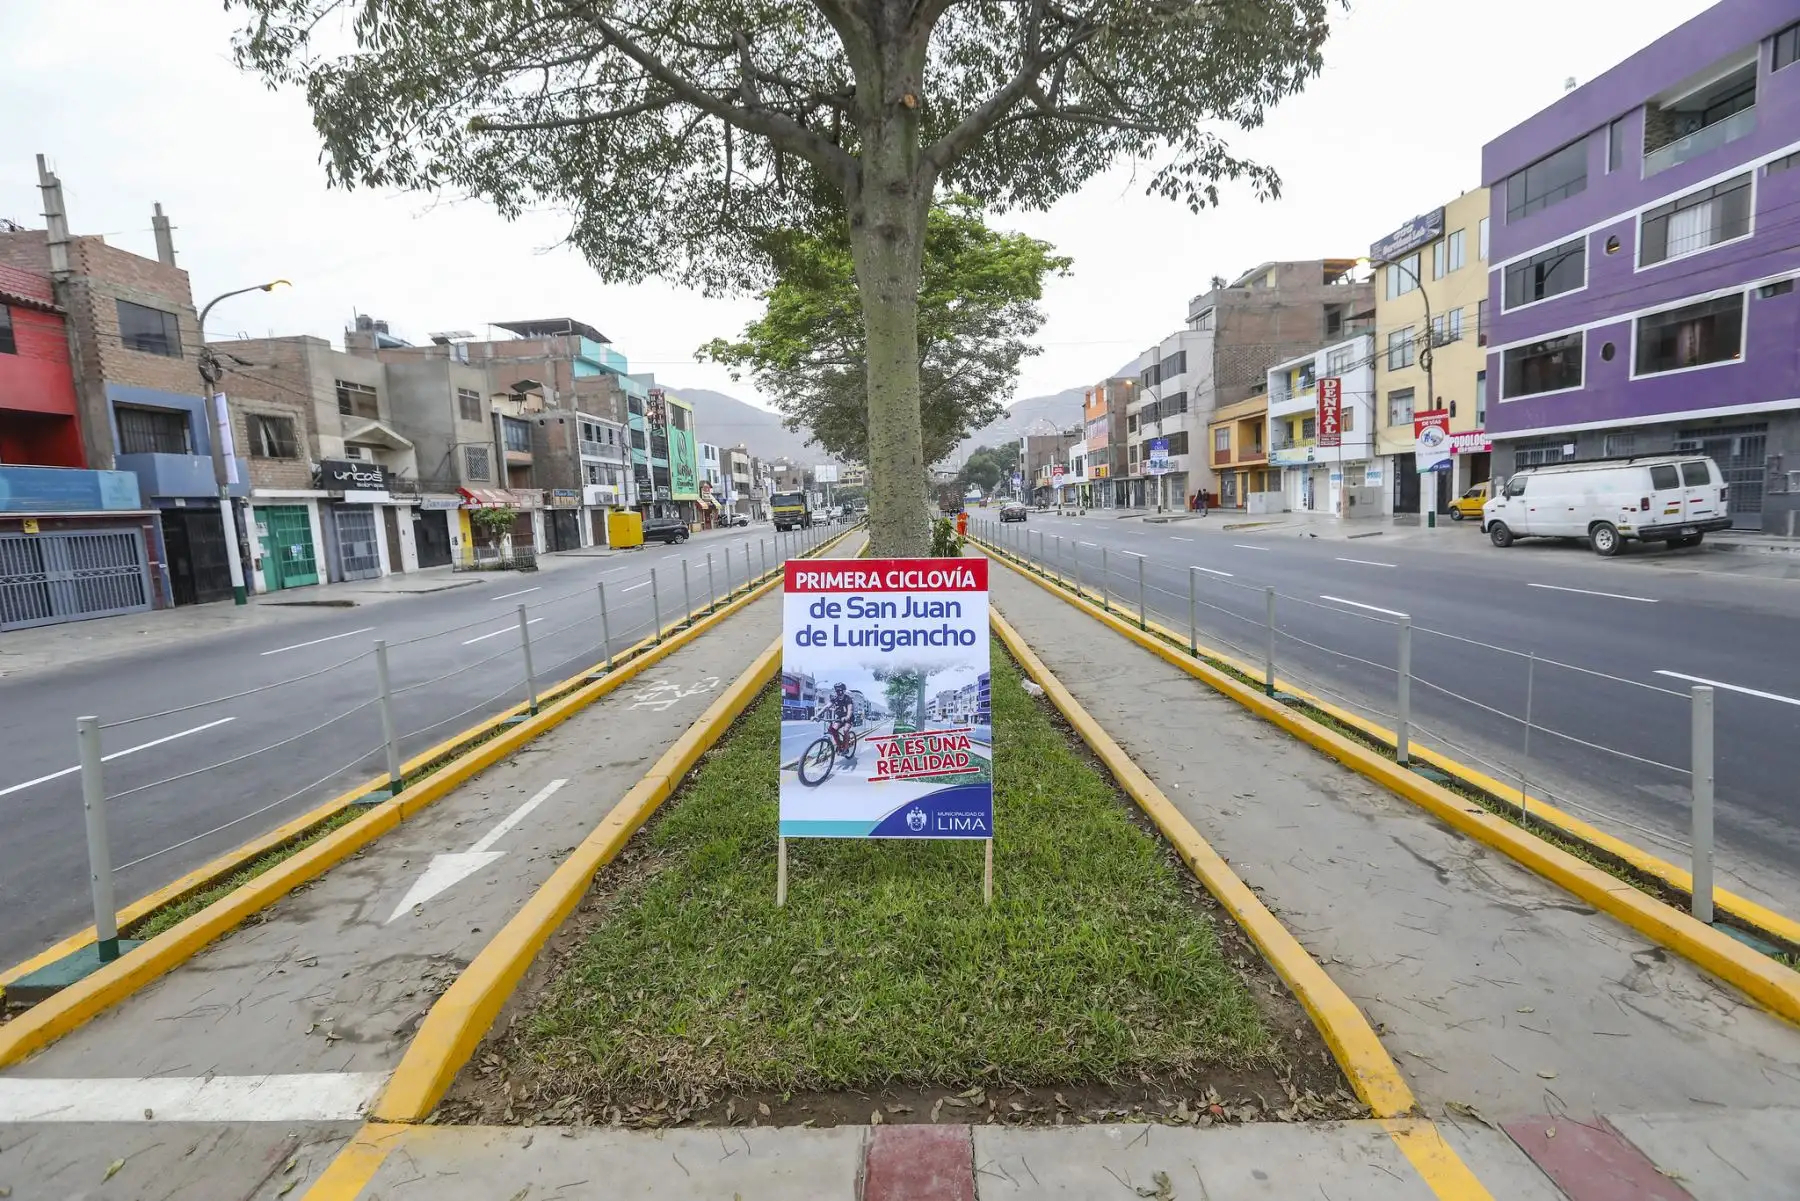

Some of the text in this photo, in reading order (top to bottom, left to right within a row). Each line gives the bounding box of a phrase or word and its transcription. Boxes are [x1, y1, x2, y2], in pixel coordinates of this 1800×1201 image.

[1323, 379, 1338, 434] DENTAL
[795, 566, 976, 589] PRIMERA CICLOVÍA
[809, 596, 961, 619] de San Juan
[795, 624, 976, 653] de Lurigancho
[875, 735, 971, 758] YA ES UNA
[876, 752, 969, 775] REALIDAD
[938, 818, 986, 831] LIMA
